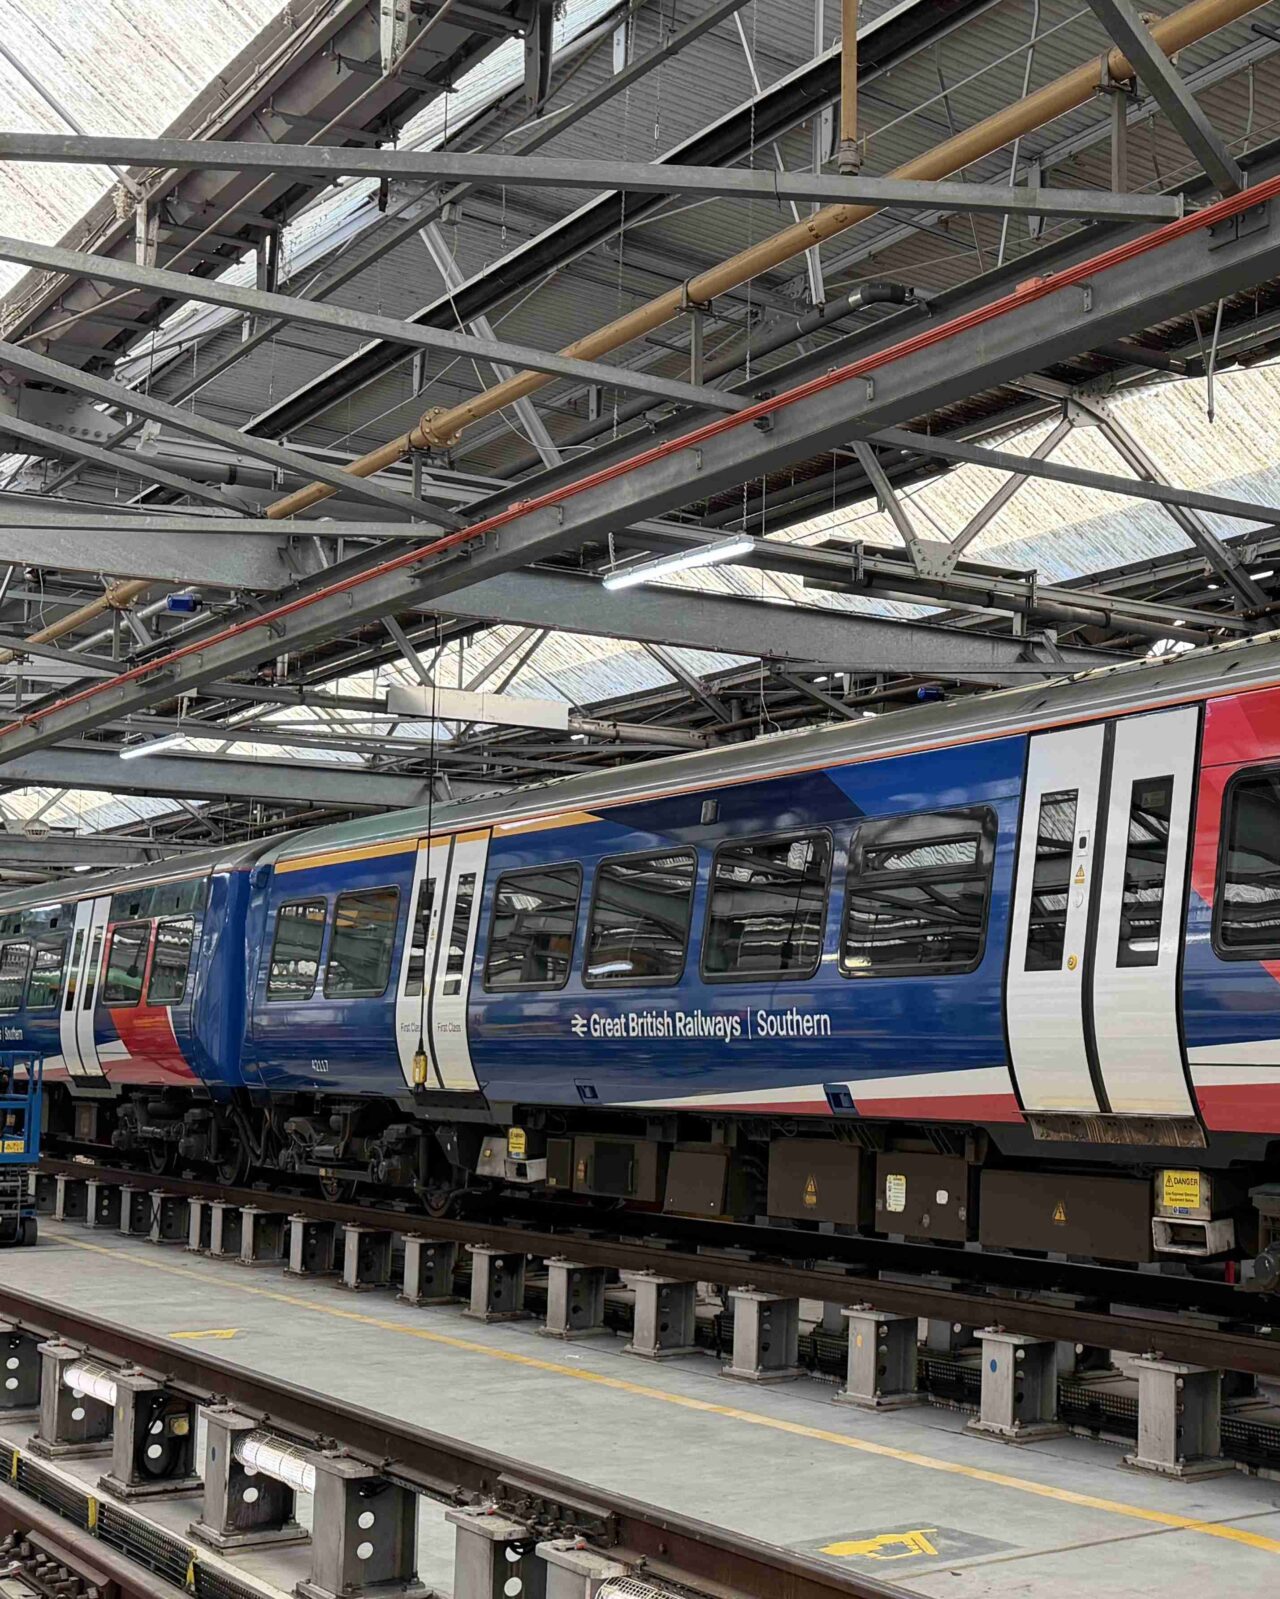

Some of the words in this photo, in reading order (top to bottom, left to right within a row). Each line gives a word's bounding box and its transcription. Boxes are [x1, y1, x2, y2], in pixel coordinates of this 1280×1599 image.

[400, 1022, 411, 1033] First
[437, 1022, 448, 1033] First
[448, 1022, 462, 1033] Class
[589, 1013, 627, 1037] Great
[629, 1010, 673, 1037] British
[675, 1009, 741, 1043] Railways
[757, 1007, 831, 1036] Southern
[4, 1026, 23, 1040] Southern
[1173, 1177, 1199, 1186] DANGER
